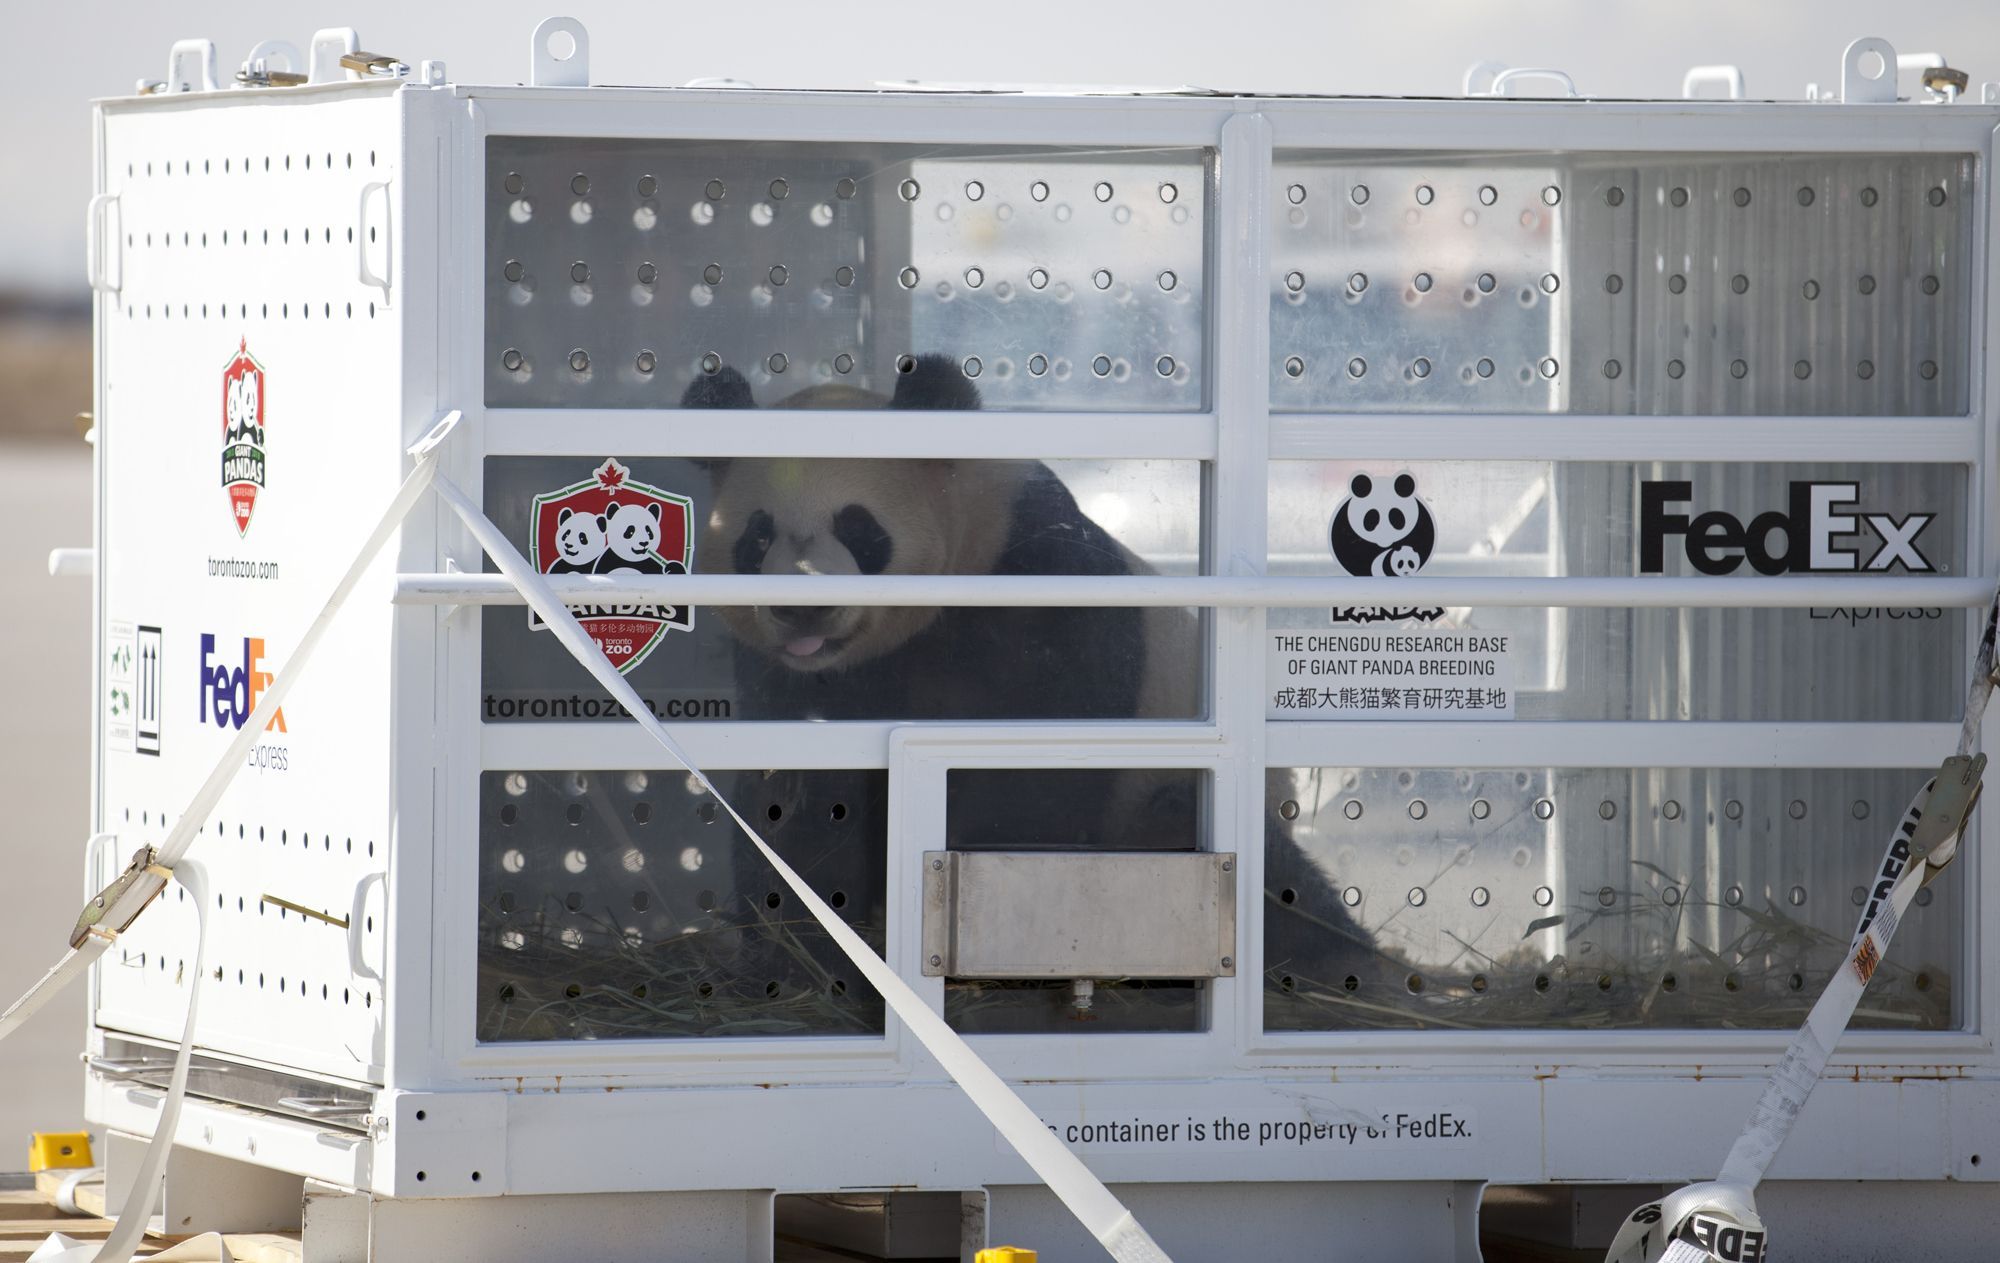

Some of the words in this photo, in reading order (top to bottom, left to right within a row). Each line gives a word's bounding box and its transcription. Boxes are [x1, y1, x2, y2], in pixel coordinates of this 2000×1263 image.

[224, 457, 263, 484] PANDAS
[1640, 481, 1938, 576] FedEx
[208, 555, 279, 580] torontozoo.com
[1275, 636, 1304, 652] THE
[1308, 637, 1381, 652] CHENGDU
[1386, 637, 1464, 653] RESEARCH
[1468, 637, 1508, 653] BASE
[1288, 660, 1306, 675] OF
[1311, 660, 1358, 675] GIANT
[1362, 660, 1415, 675] PANDA
[1419, 660, 1495, 676] BREEDING
[1275, 687, 1507, 709] 成都大熊猫繁育研究基地
[1066, 1117, 1180, 1143] container
[1187, 1116, 1206, 1142] is
[1212, 1116, 1251, 1142] the
[1396, 1113, 1472, 1138] FedEx.
